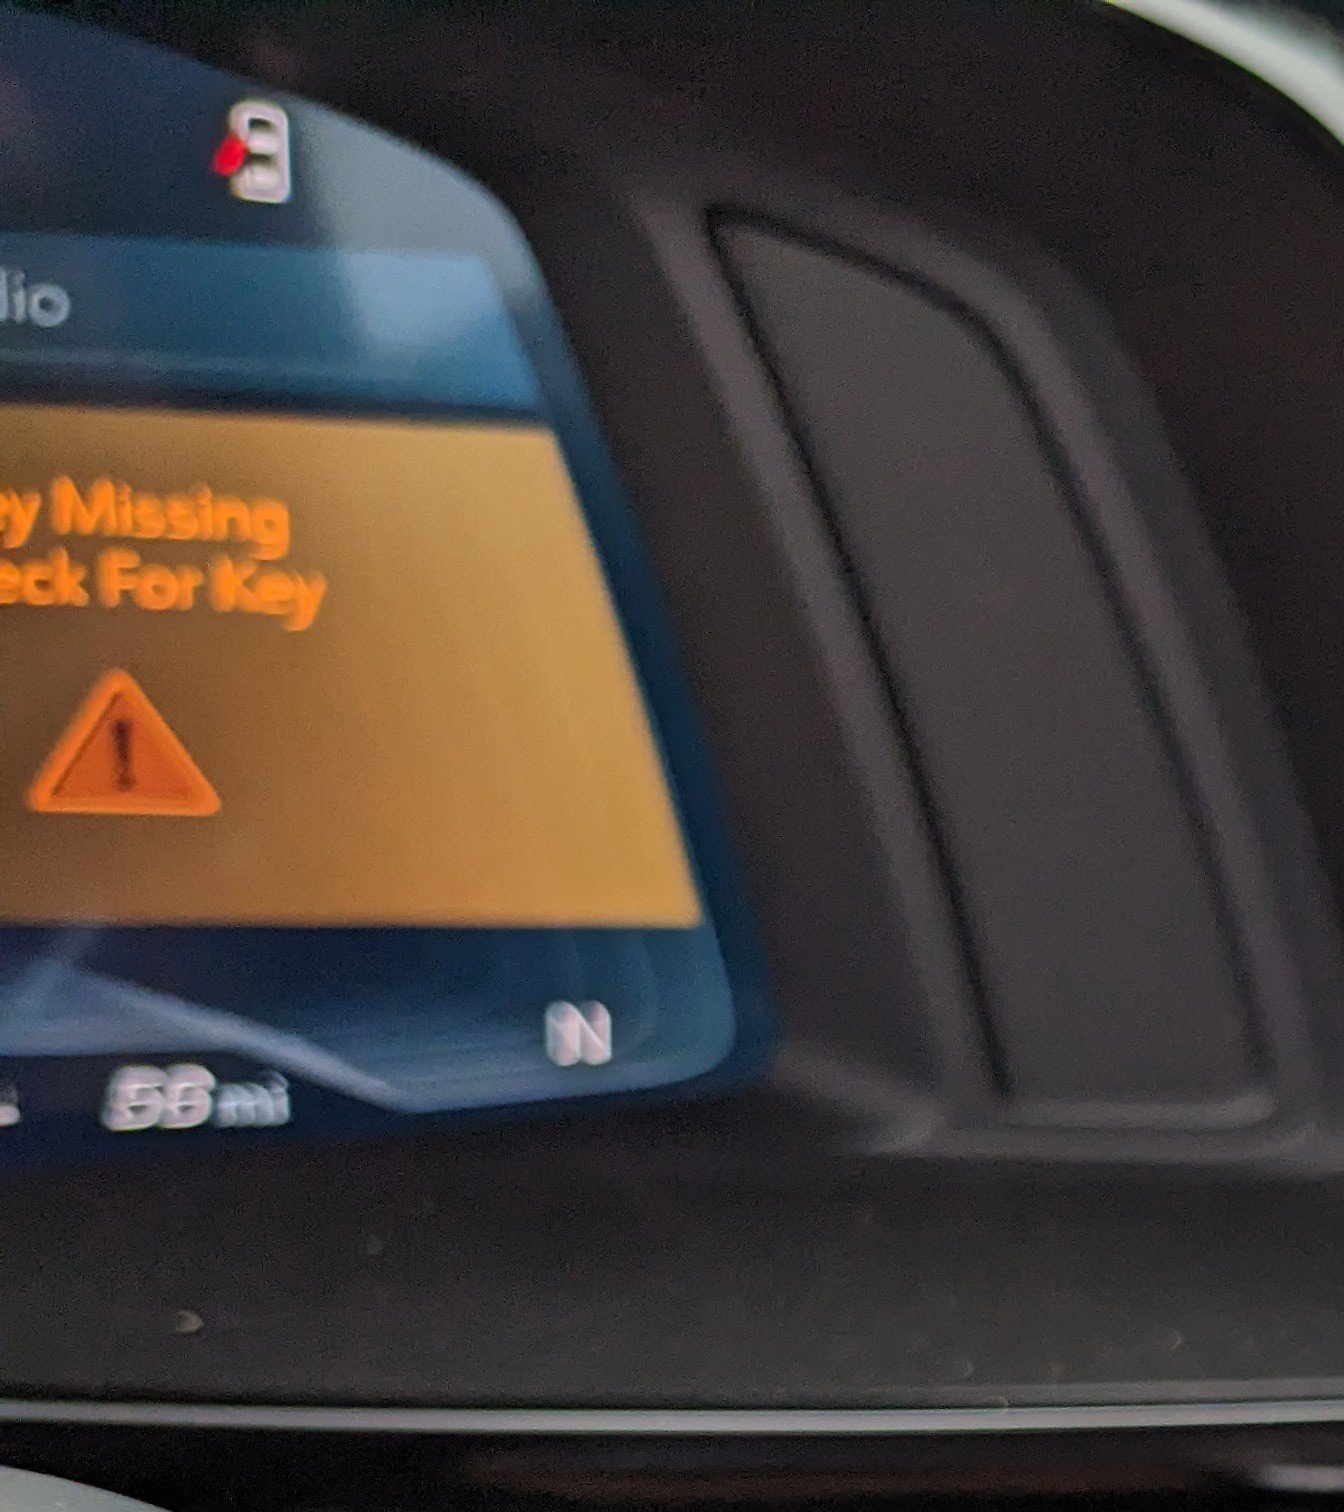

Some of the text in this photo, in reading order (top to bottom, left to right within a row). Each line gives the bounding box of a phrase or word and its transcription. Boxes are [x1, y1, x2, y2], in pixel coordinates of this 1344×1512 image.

[0, 265, 70, 327] io
[51, 475, 290, 561] Missing
[97, 547, 203, 611] For
[208, 554, 328, 632] Key
[546, 1001, 612, 1066] N
